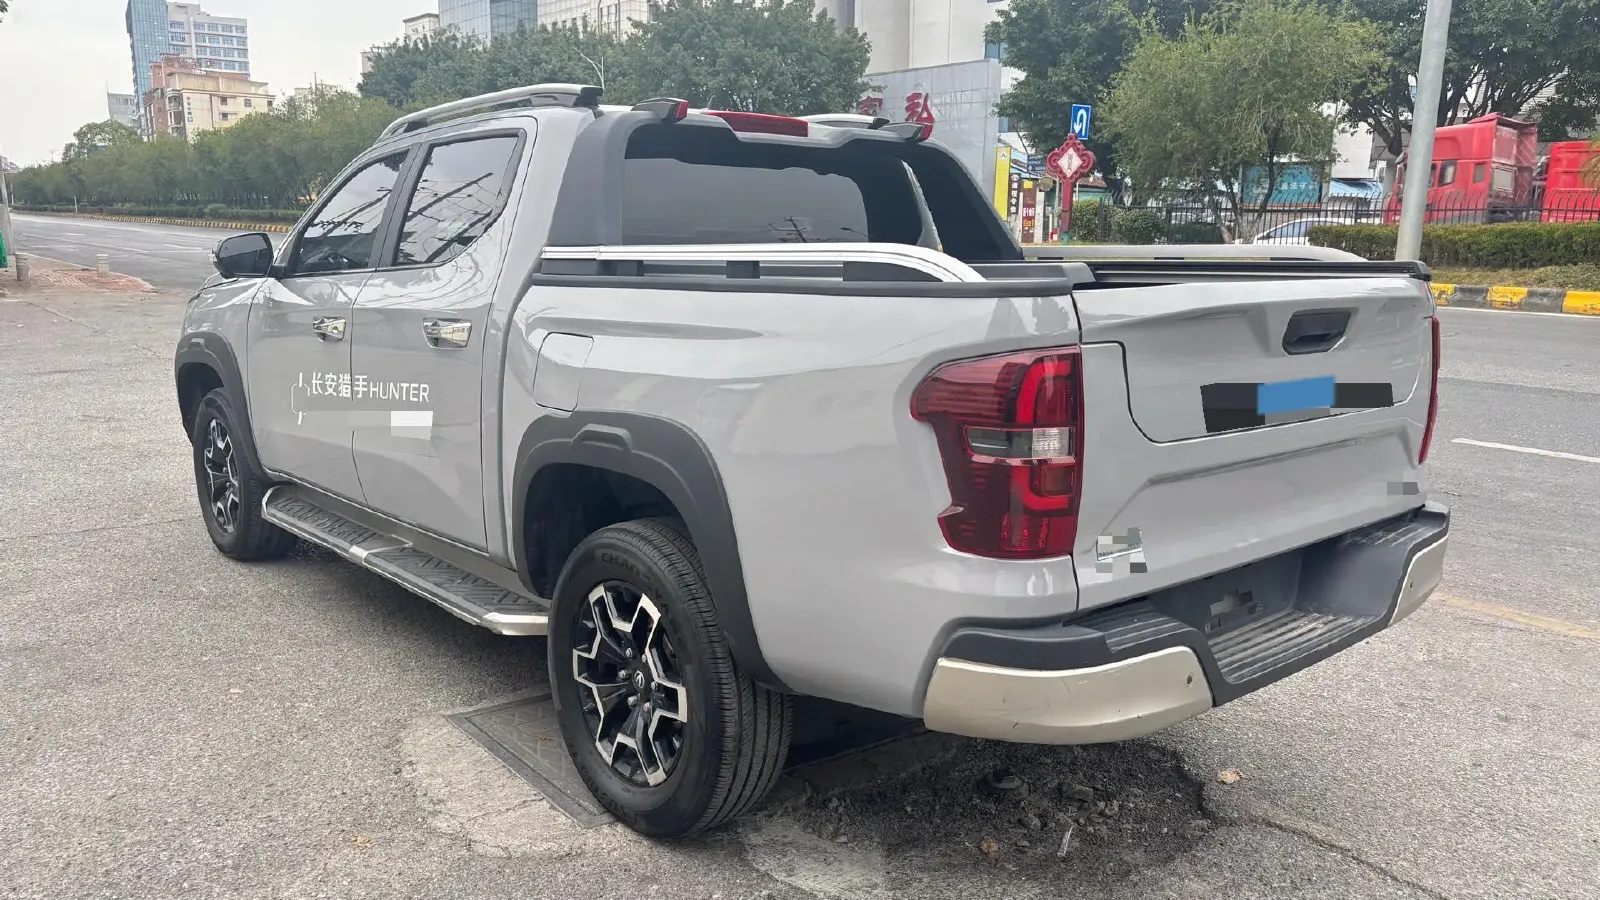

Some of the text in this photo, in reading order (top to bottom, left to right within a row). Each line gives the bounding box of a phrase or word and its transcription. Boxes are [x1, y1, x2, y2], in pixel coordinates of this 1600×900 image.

[312, 372, 429, 402] 长安猎手 HUNTER
